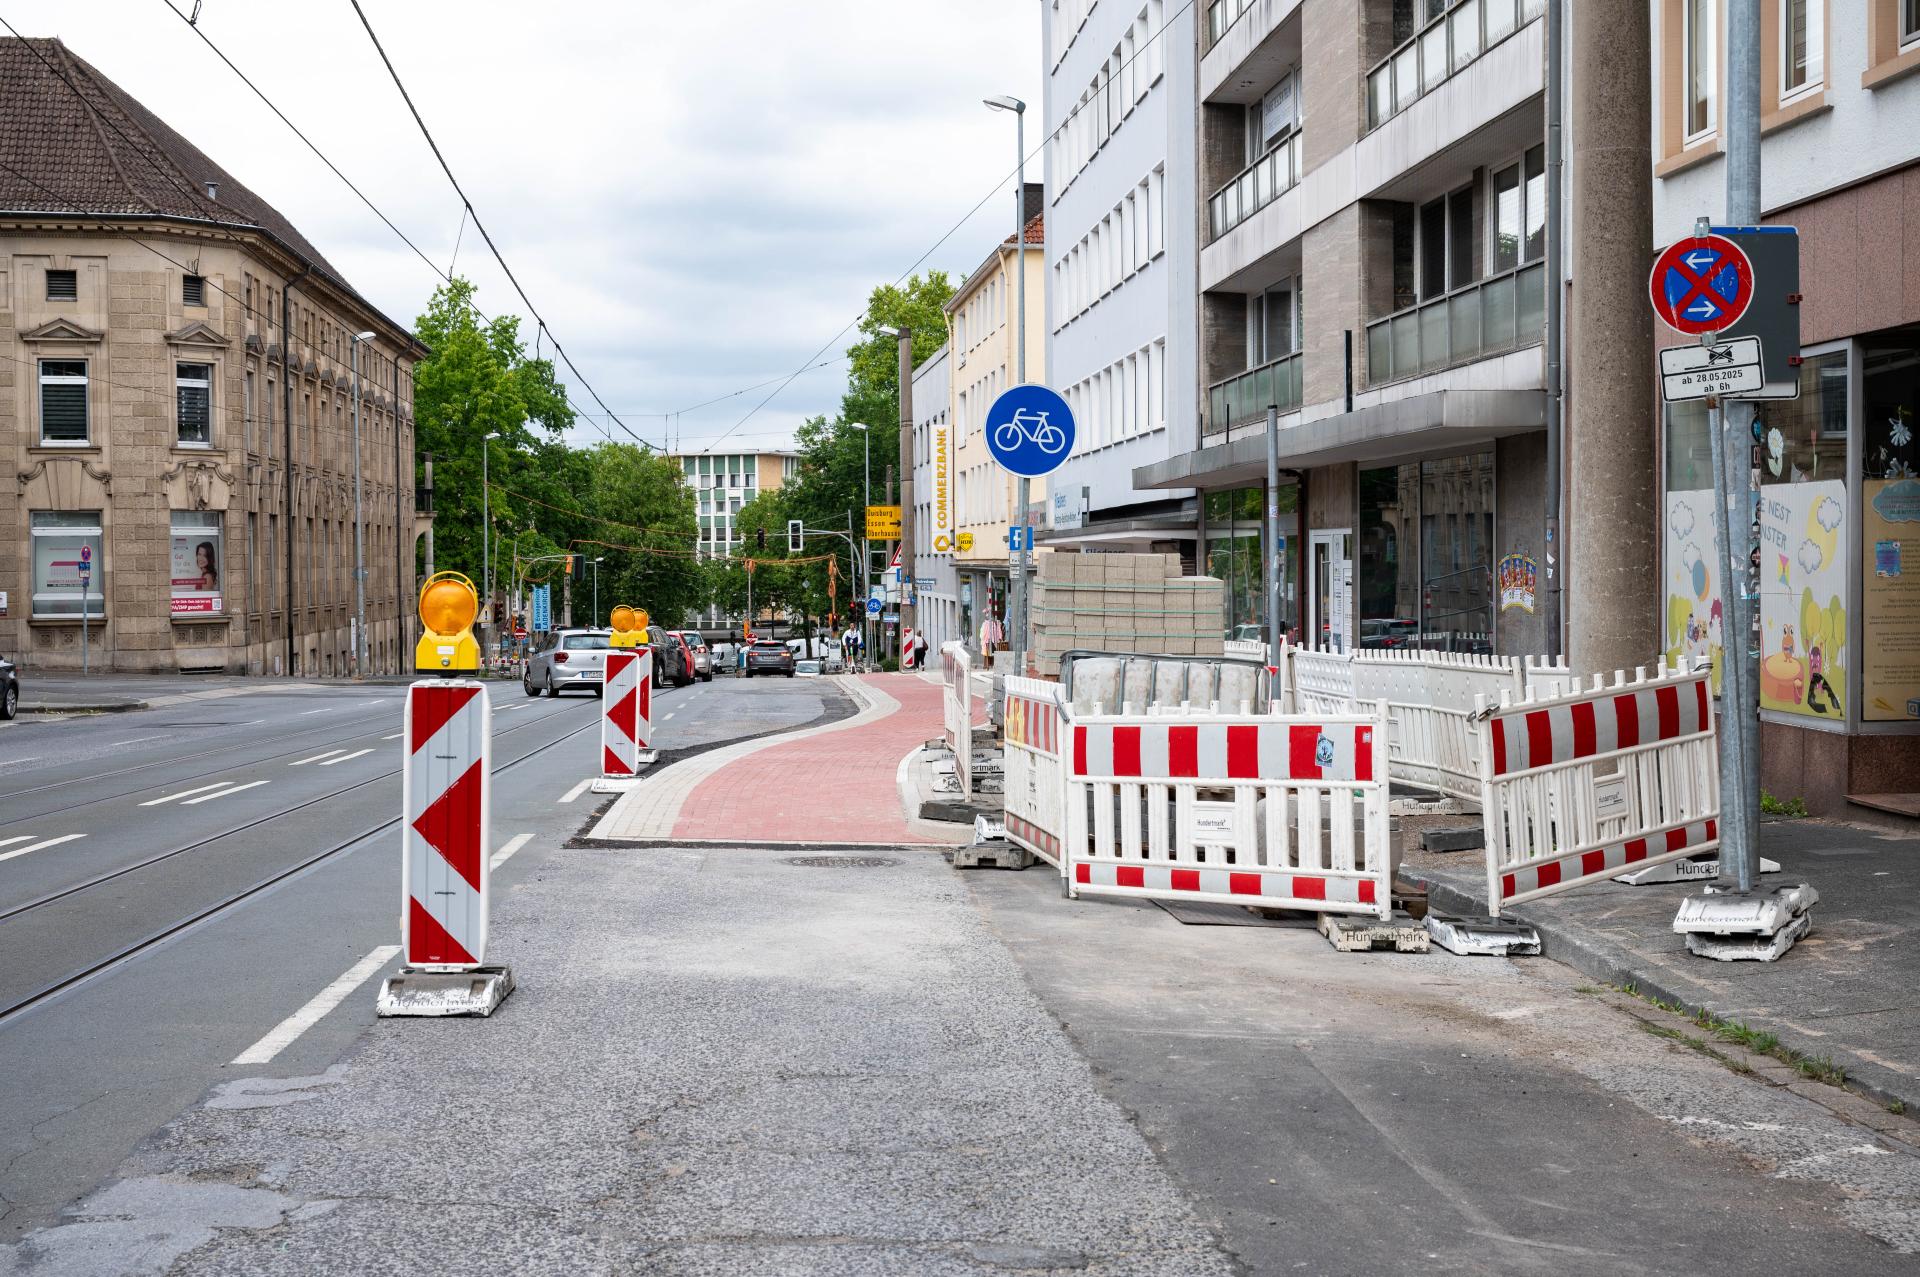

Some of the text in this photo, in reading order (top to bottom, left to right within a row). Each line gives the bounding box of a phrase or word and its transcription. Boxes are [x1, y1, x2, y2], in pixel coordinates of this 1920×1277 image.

[1682, 370, 1743, 384] ab 28.05.2025
[1704, 382, 1731, 392] ab 6h
[936, 429, 947, 529] COMMERZBANK
[867, 509, 893, 517] Duisburg
[1768, 499, 1792, 525] NEST
[951, 764, 1001, 772] Hertmark
